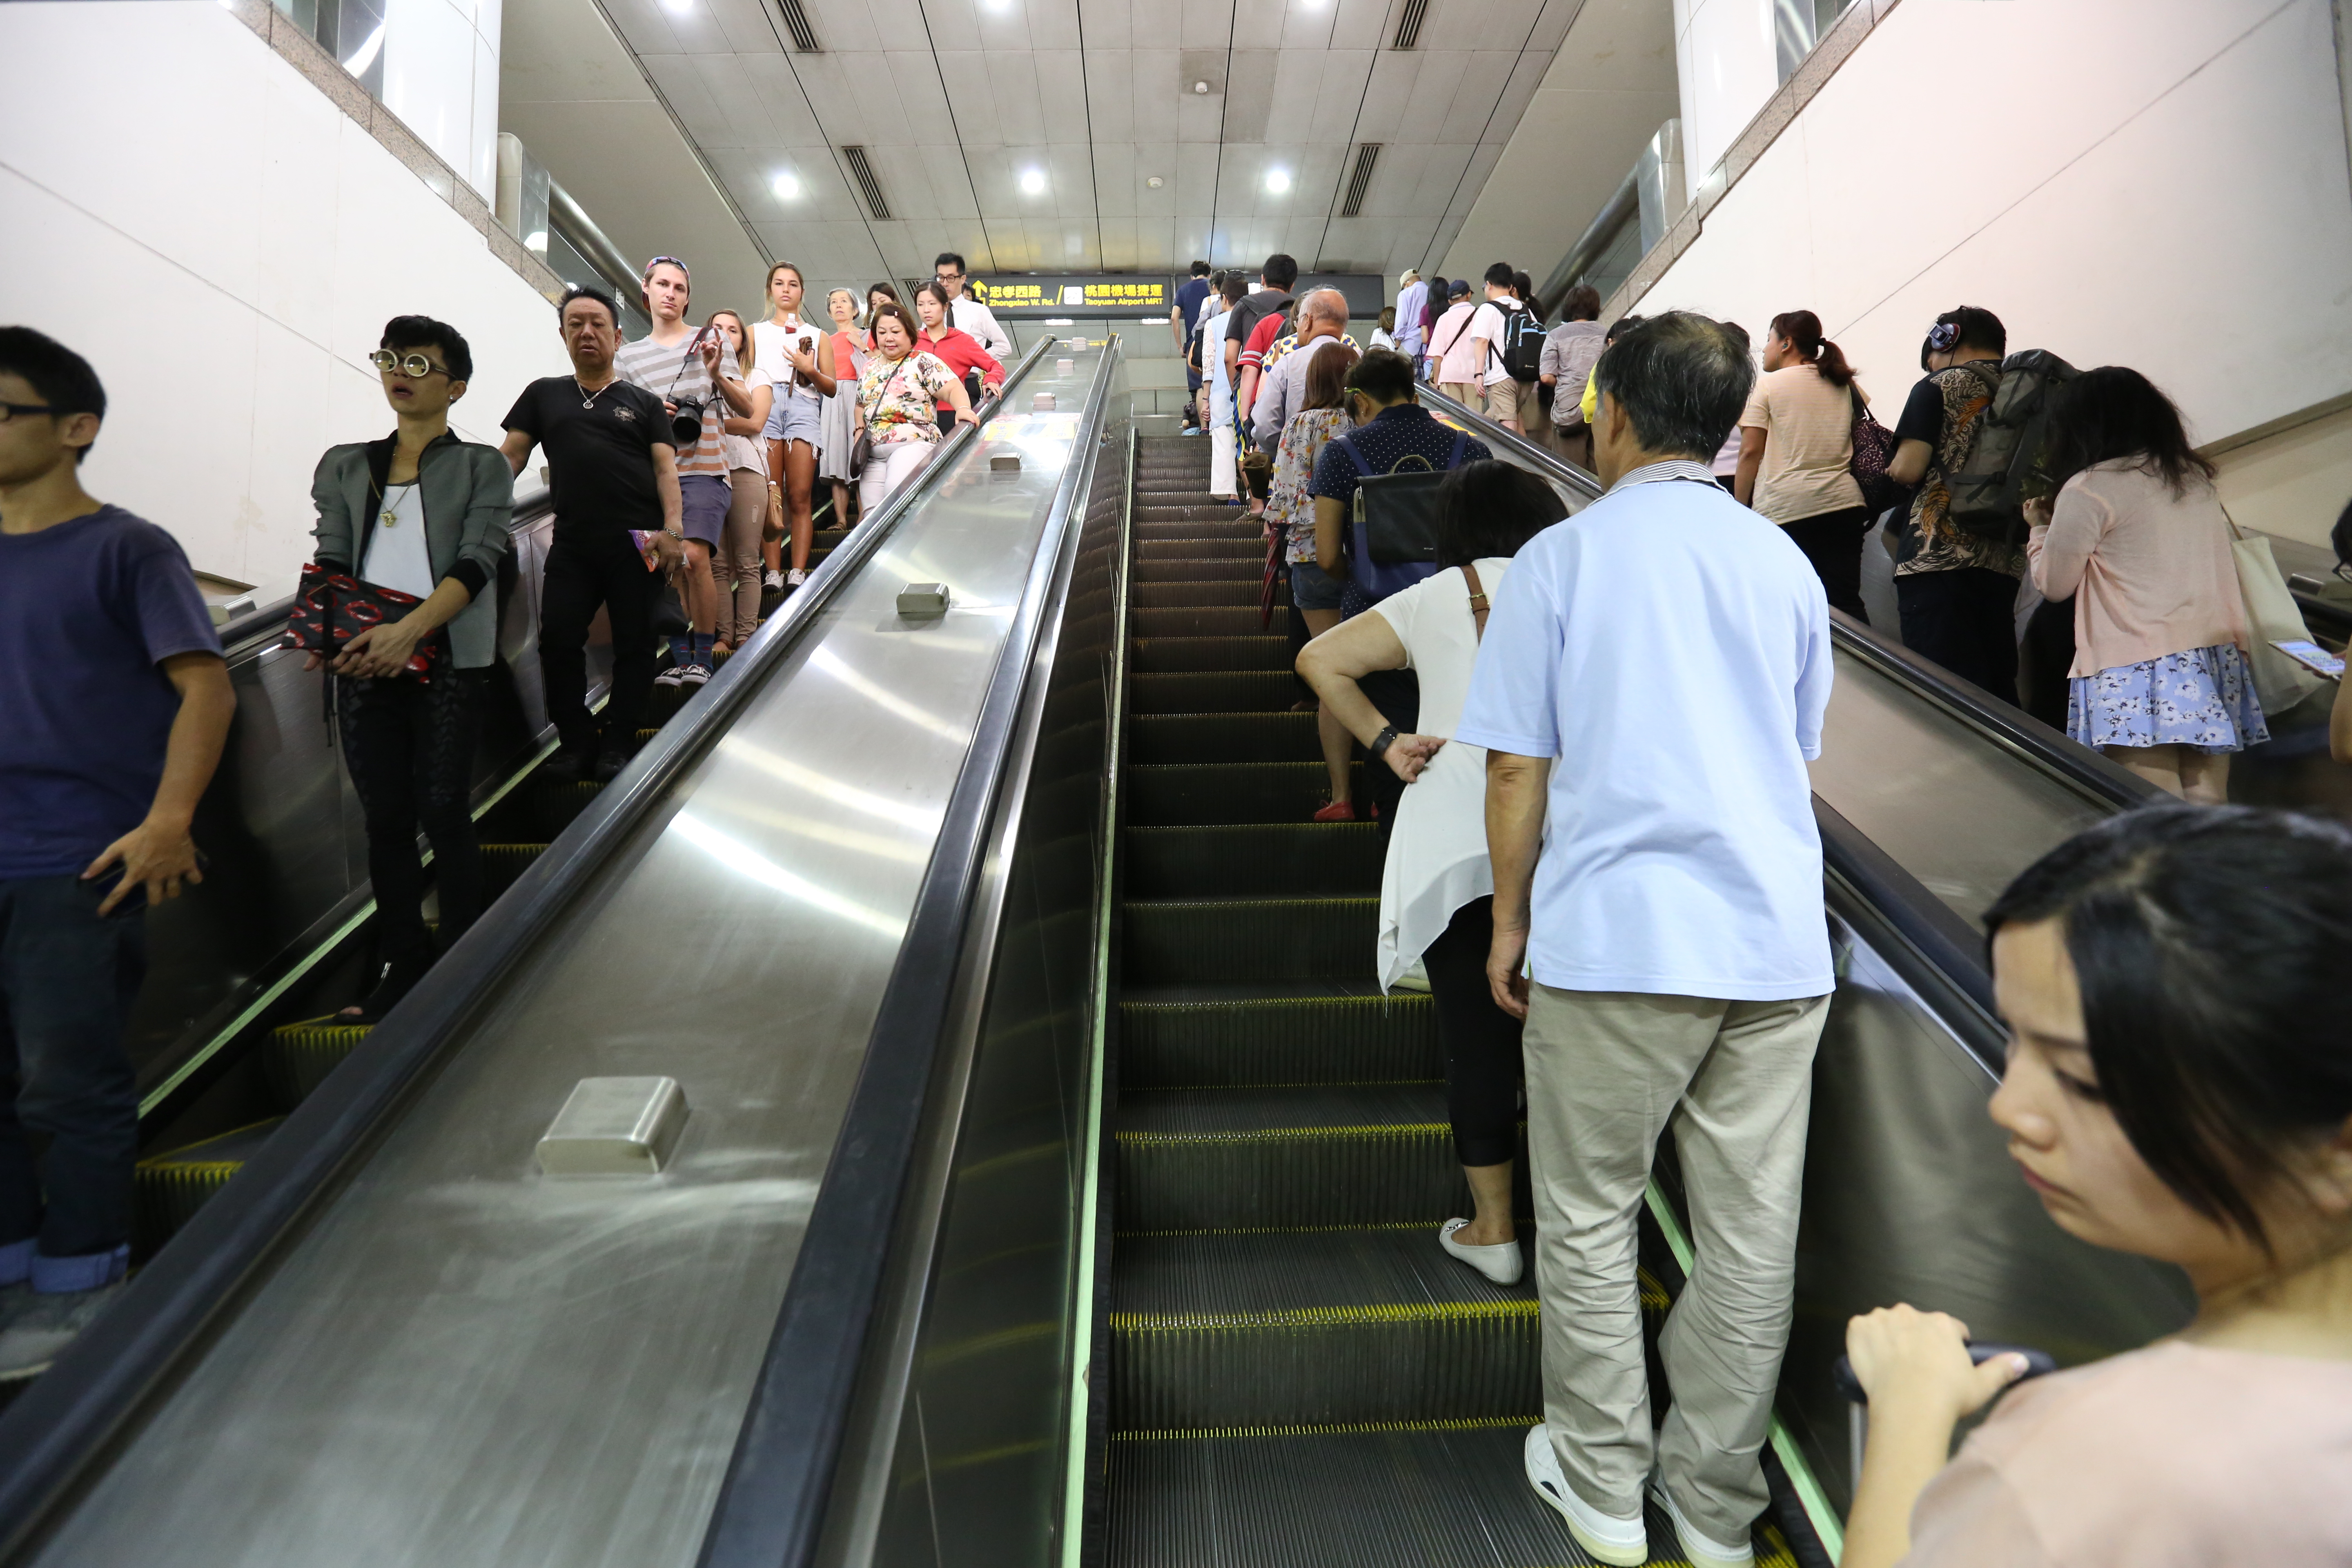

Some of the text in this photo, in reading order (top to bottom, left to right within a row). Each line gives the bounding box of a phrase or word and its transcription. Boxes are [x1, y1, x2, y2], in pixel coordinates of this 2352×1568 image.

[989, 285, 1042, 298] 忠孝西路
[1085, 284, 1163, 297] 桃園機場捷運
[989, 299, 1029, 307] Zhongxiao
[1084, 298, 1116, 306] Taoyuan
[1118, 298, 1144, 306] Airport
